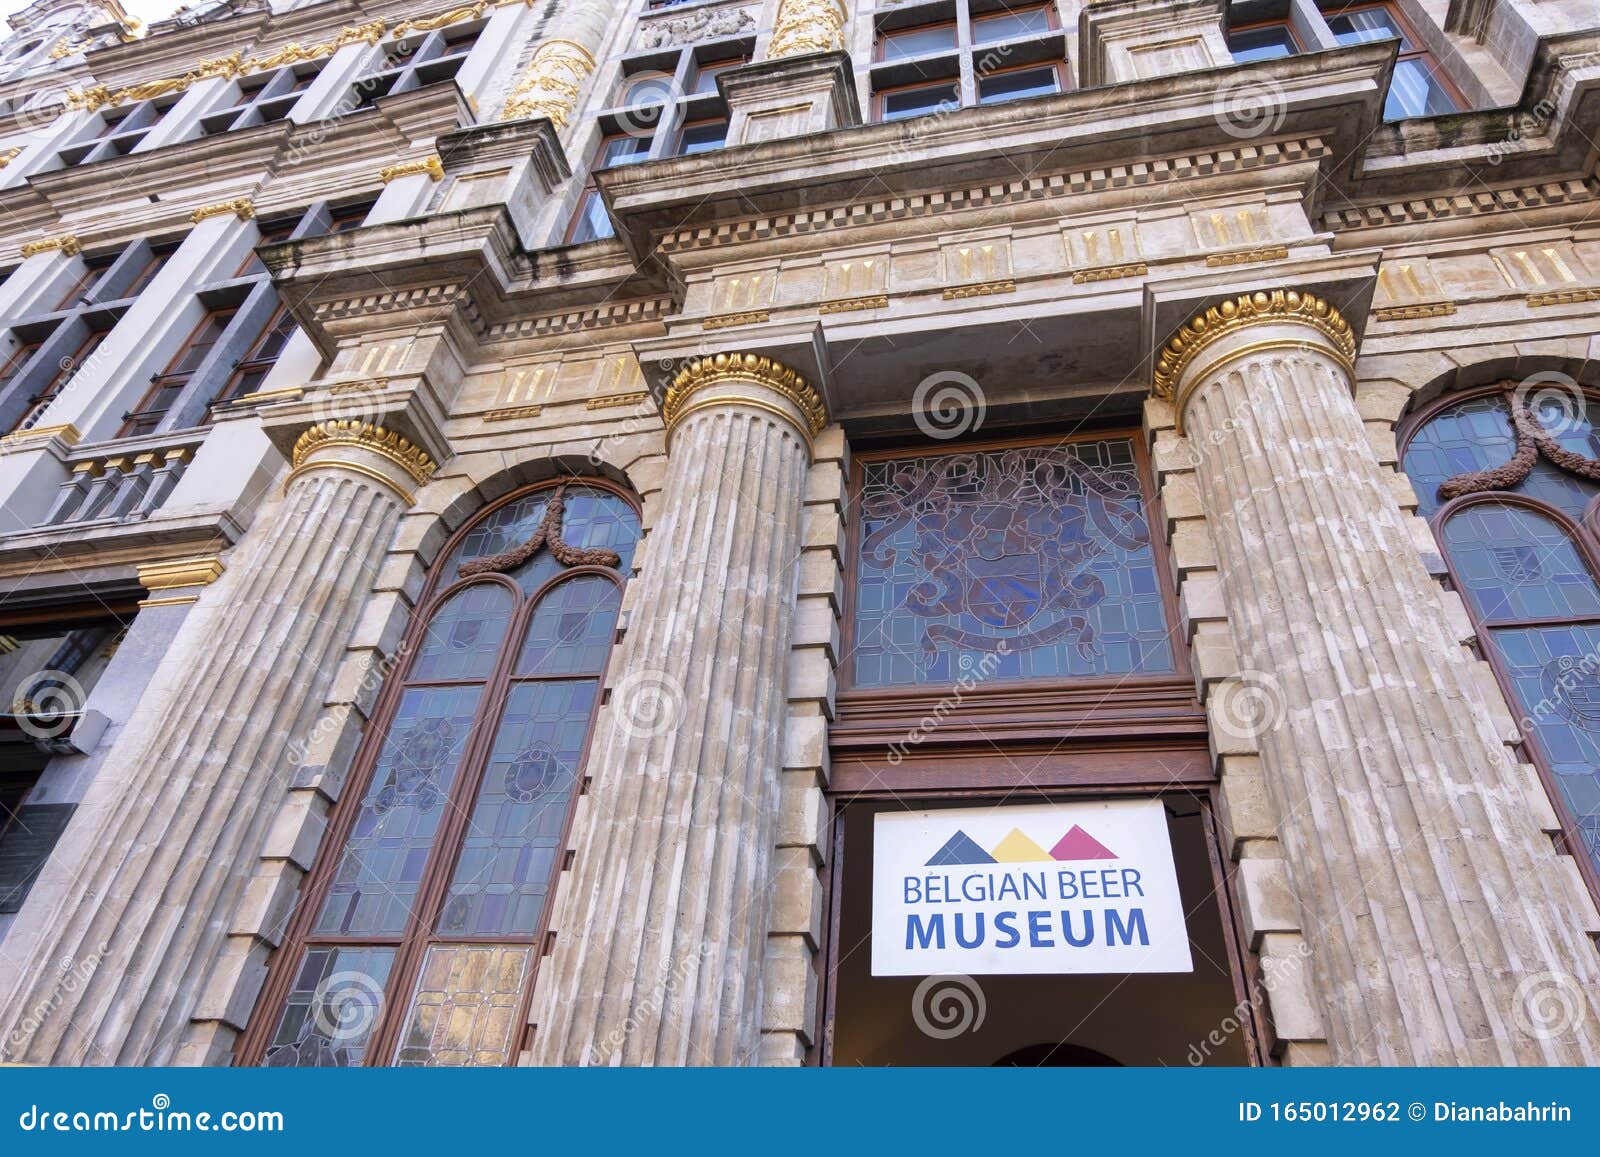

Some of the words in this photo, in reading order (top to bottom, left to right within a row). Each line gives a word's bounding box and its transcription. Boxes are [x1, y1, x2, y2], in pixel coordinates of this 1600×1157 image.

[904, 871, 1047, 904] BELGIAN
[1057, 868, 1145, 899] BEER
[905, 908, 1150, 950] MUSEUM
